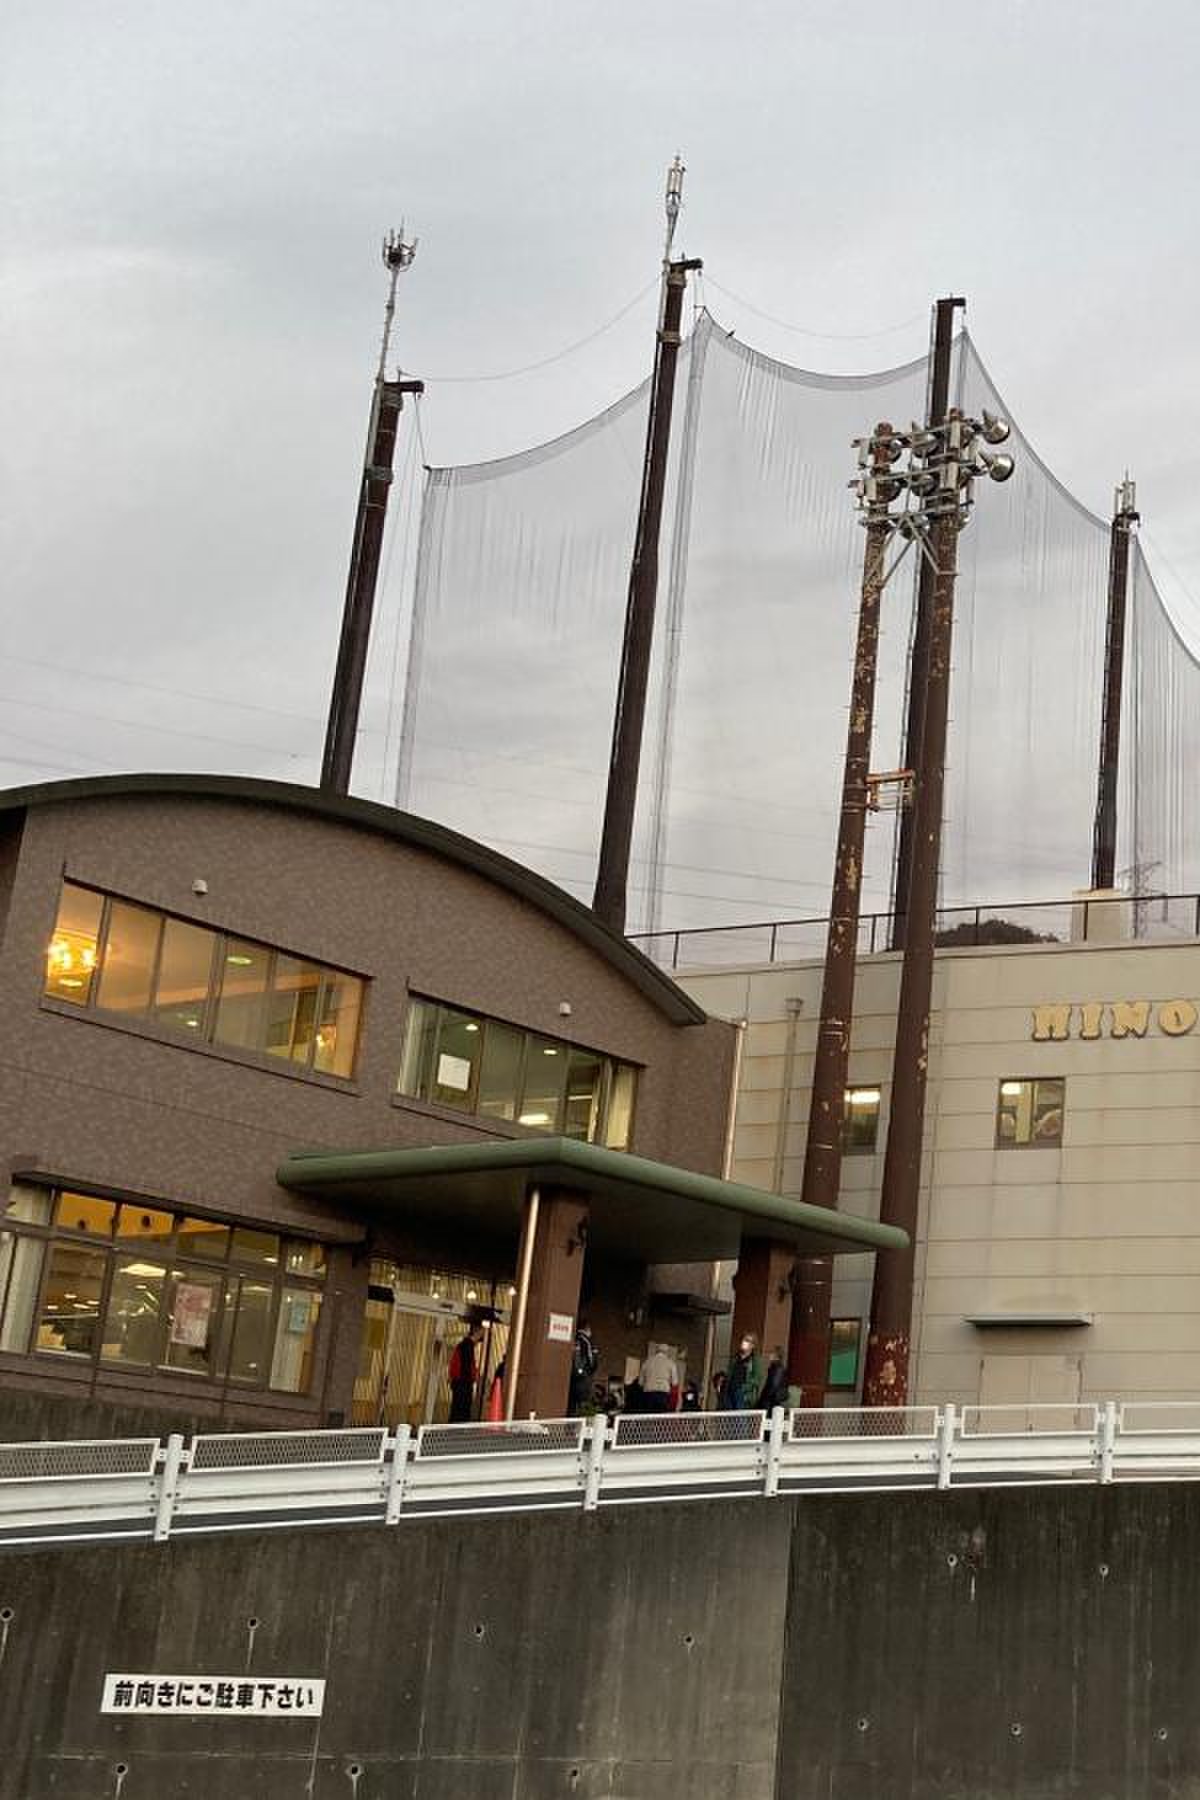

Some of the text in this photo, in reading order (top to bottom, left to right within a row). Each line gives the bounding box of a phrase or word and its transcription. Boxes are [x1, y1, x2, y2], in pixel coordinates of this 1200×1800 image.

[112, 1679, 315, 1710] 前向きにご駐車下さい
